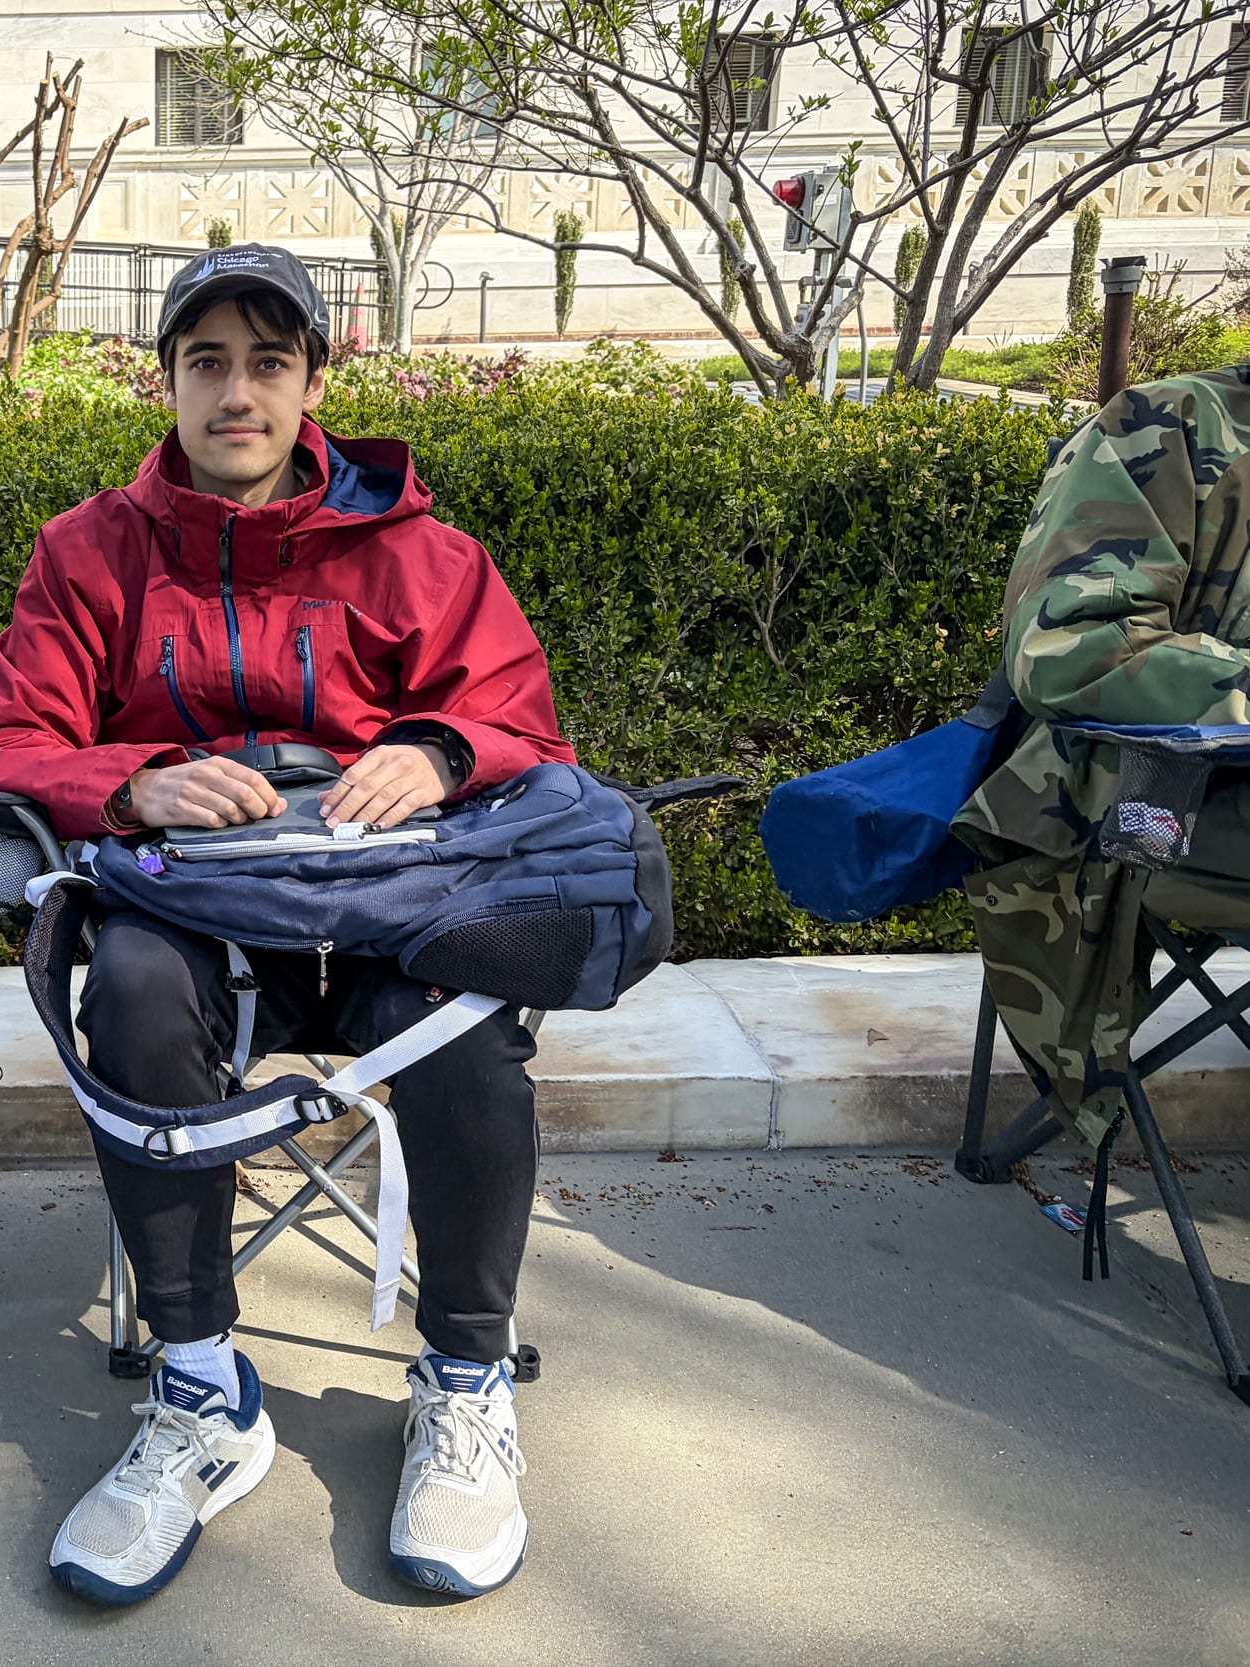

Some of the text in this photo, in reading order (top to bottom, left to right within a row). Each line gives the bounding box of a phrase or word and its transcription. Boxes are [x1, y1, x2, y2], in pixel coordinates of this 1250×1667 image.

[216, 256, 259, 264] Chicago
[441, 1365, 486, 1377] Babolat
[167, 1376, 209, 1397] Babolat
